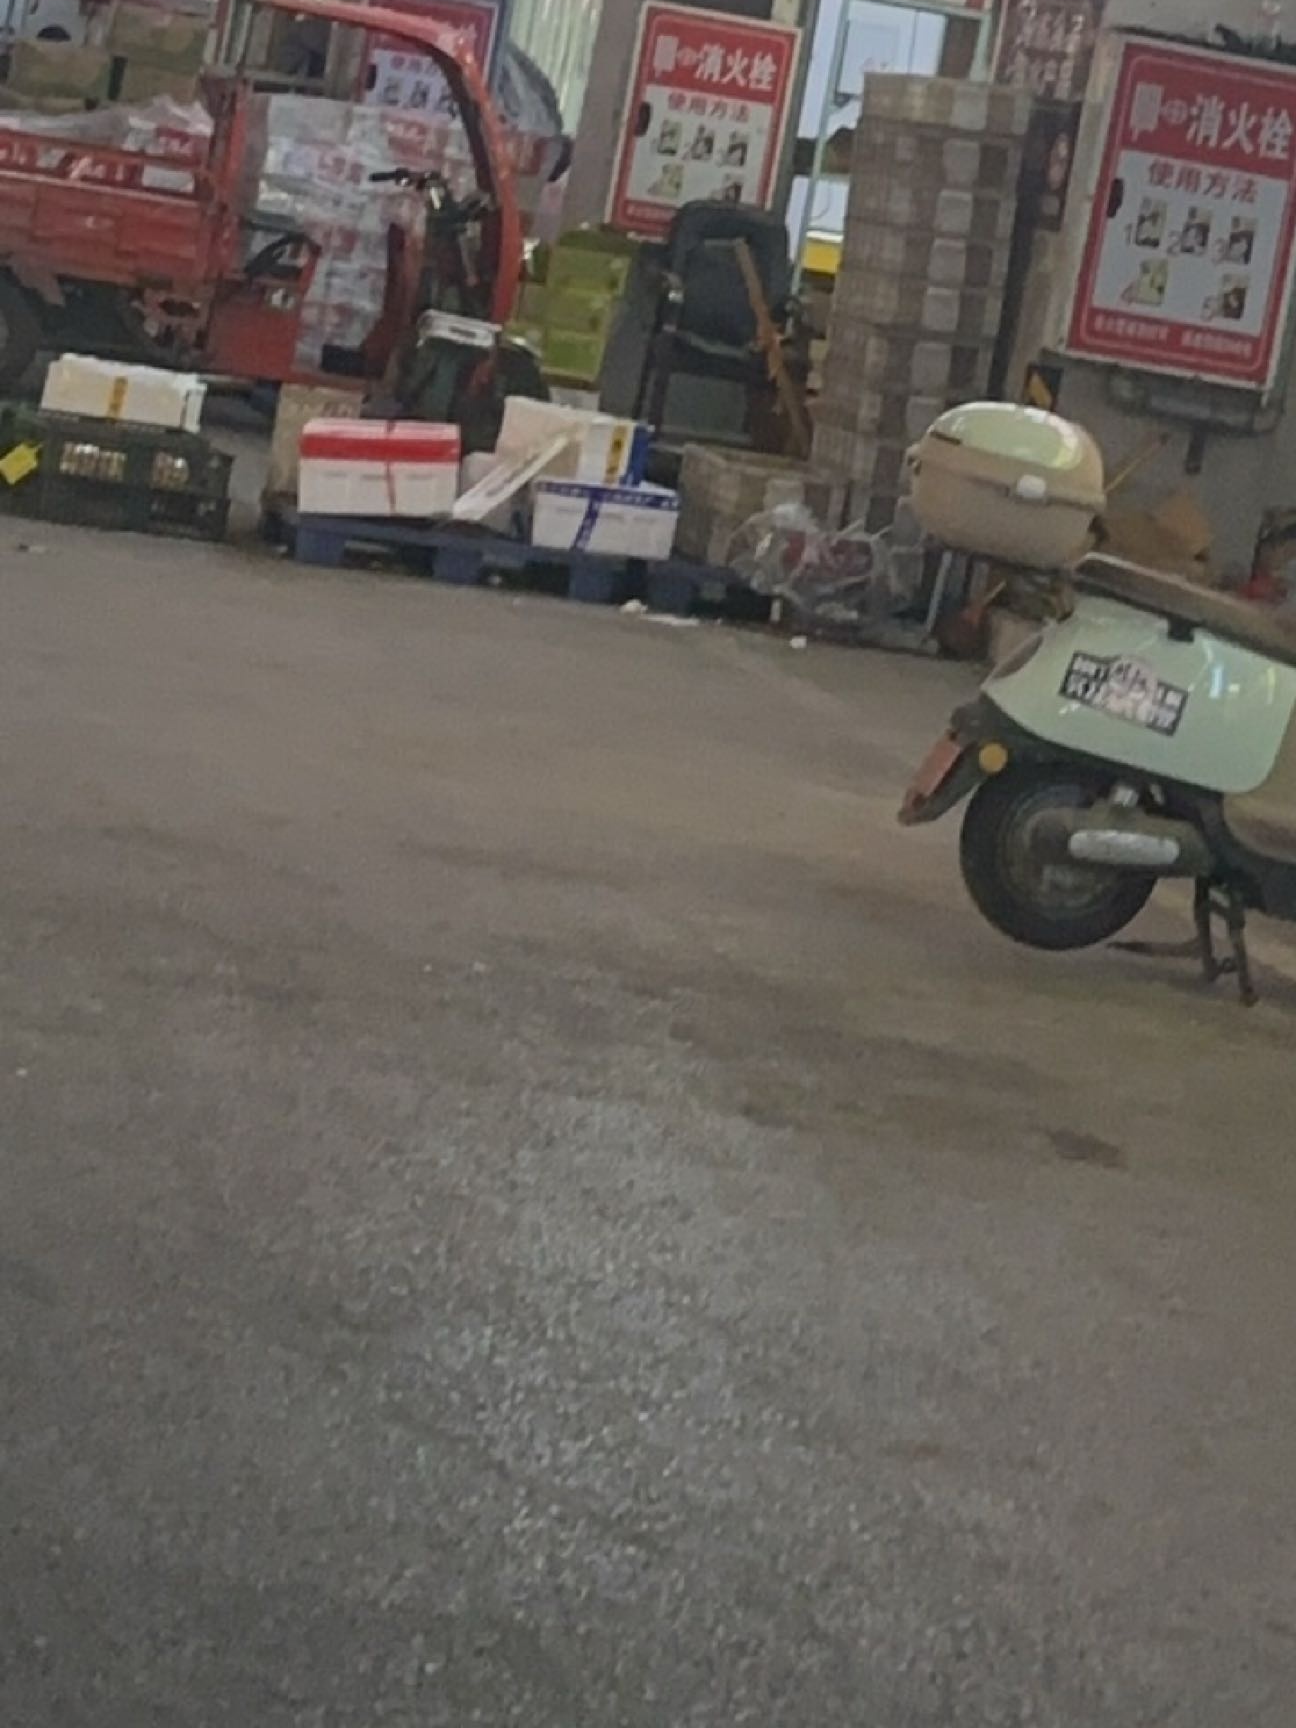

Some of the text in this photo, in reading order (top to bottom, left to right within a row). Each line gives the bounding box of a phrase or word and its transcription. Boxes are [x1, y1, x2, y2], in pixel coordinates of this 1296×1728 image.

[693, 42, 778, 93] 消火栓
[1185, 92, 1295, 162] 消火栓
[1147, 158, 1261, 204] 使用方法
